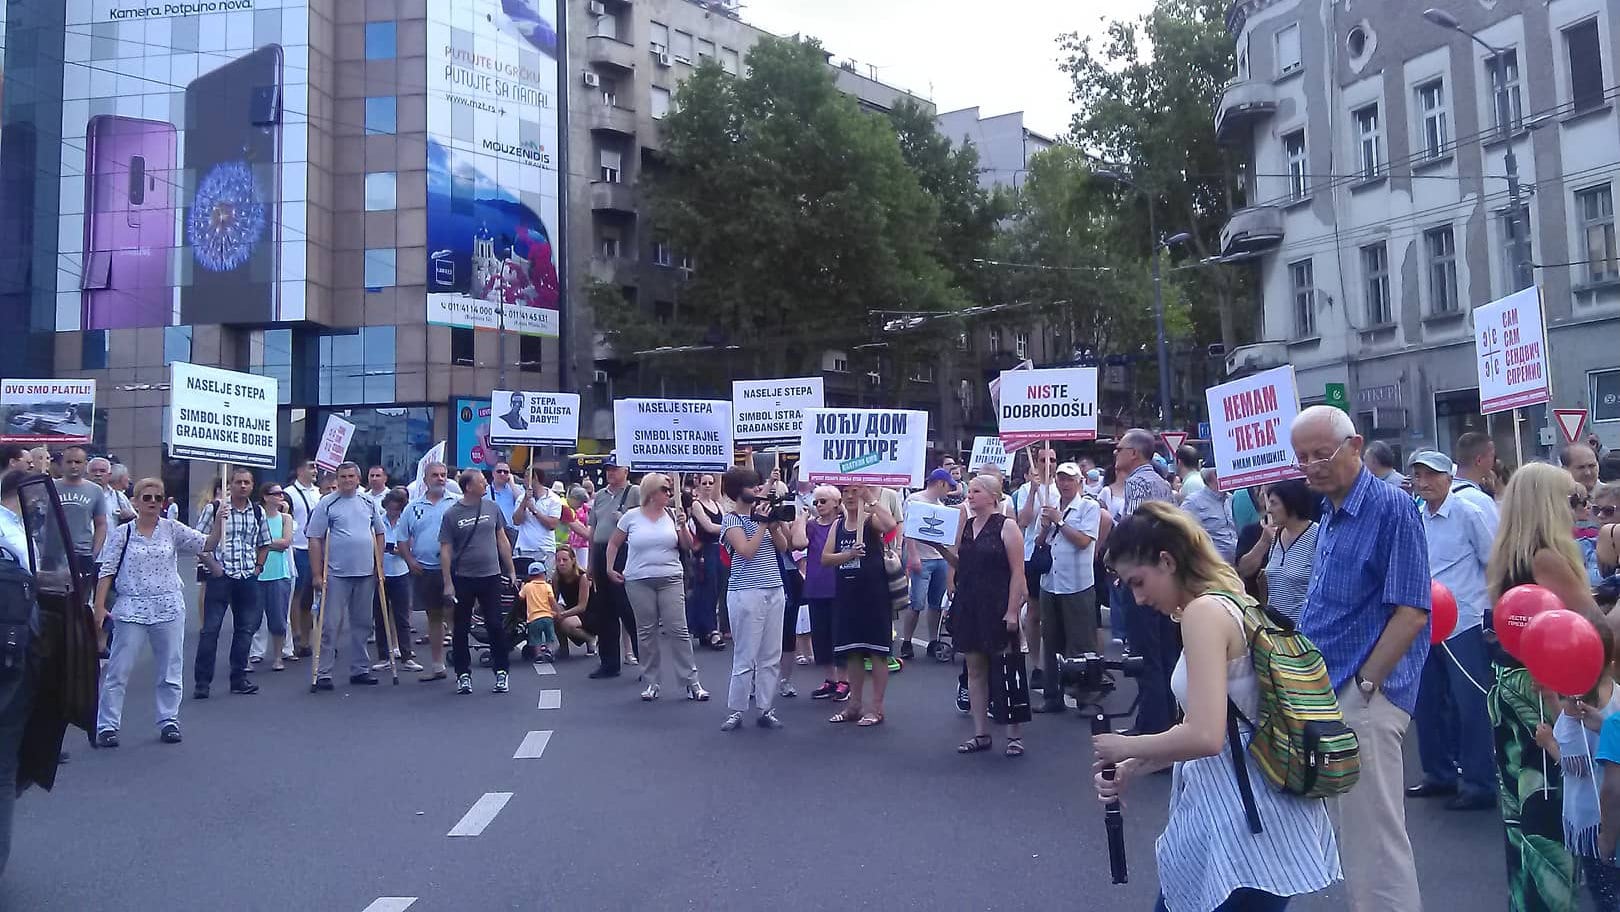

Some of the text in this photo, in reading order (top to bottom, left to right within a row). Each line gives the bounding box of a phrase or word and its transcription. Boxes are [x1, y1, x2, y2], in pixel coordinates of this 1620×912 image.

[110, 0, 253, 19] Kamera. Potpuno nova.
[445, 46, 491, 69] PUTUJTE
[495, 61, 503, 72] U
[445, 65, 548, 108] PUTUJTE SA NAMA!
[445, 93, 496, 113] www.mzt.rs
[482, 139, 550, 163] MOUZENIDIS
[1502, 308, 1519, 328] САМ
[1503, 328, 1520, 347] САМ
[1505, 341, 1540, 366] СЕНДВИЧ
[5, 385, 91, 394] OVO SMO PLATILI!
[187, 376, 265, 400] NASELJE STEPA
[743, 386, 813, 398] NASELJE STEPA
[1027, 384, 1068, 400] NISTE
[530, 397, 556, 405] STEPA
[530, 406, 572, 415] DA BLISTA
[638, 402, 713, 414] NASELJE STEPA
[1003, 398, 1093, 419] DOBRODOŠLI
[1223, 384, 1278, 422] НЕМАМ
[180, 408, 271, 432] SIMBOL ISTRAJNE
[530, 415, 559, 424] BABY!!!
[739, 410, 804, 421] SIMBOL ISTRA
[736, 422, 790, 433] GRAĐANSKE
[815, 413, 907, 438] ХОЋУ ДОМ
[176, 424, 273, 447] GRAĐANSKE BORBE
[634, 430, 719, 441] SIMBOL ISTRAJNE
[632, 444, 724, 455] GRAĐANSKE BORBE
[823, 439, 899, 461] КУЛТУРЕ
[1232, 456, 1252, 470] ИМАМ
